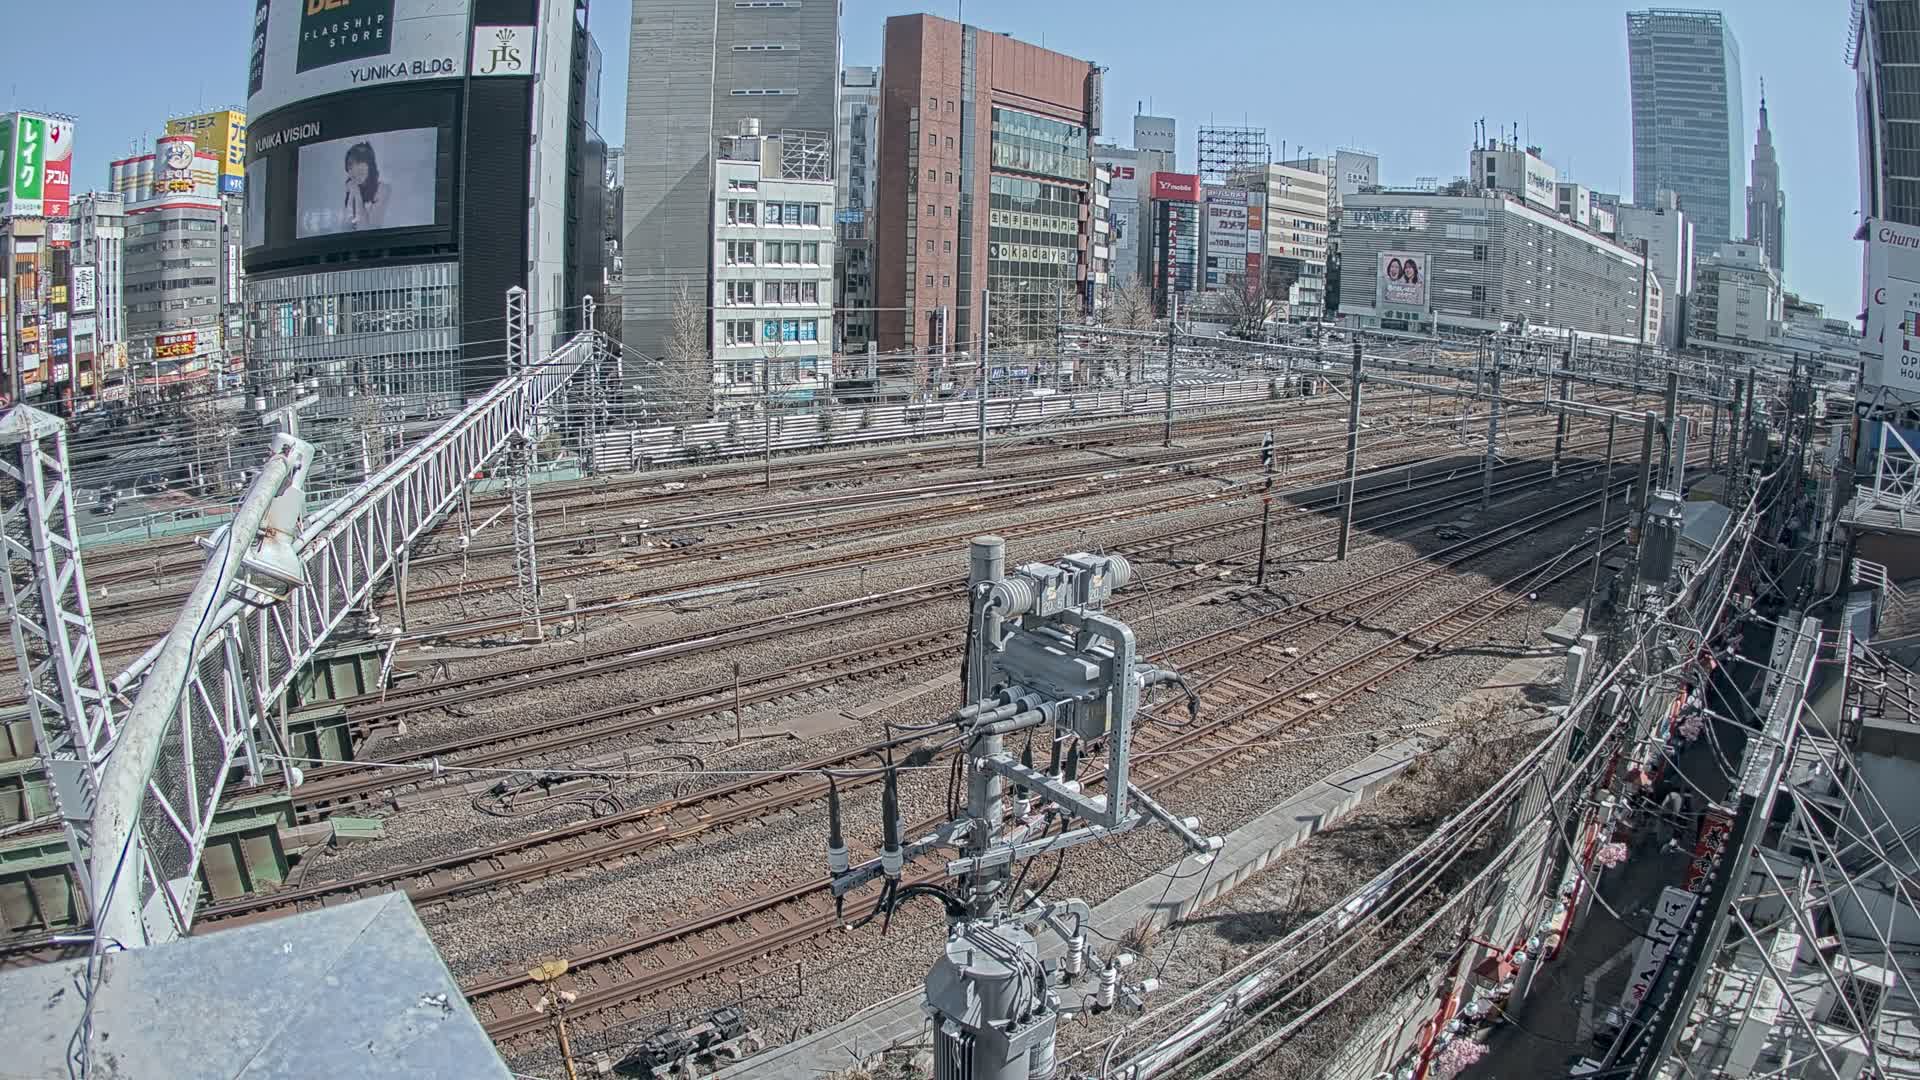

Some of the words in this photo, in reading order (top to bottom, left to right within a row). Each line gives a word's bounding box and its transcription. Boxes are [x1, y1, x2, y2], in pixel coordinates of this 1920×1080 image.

[304, 14, 384, 41] FLAGSHIP
[329, 29, 383, 48] STORE
[350, 62, 408, 83] YUNIKA
[412, 58, 456, 76] BLDG.
[176, 116, 216, 132] プロミス
[254, 131, 285, 154] YUNIKA
[282, 121, 321, 144] VISION
[20, 120, 38, 188] レイク
[46, 169, 69, 185] アコム
[1210, 207, 1246, 218] ヨドバシ
[1218, 220, 1246, 231] カメラ
[1001, 245, 1066, 262] okadaya
[1901, 355, 1920, 367] OP
